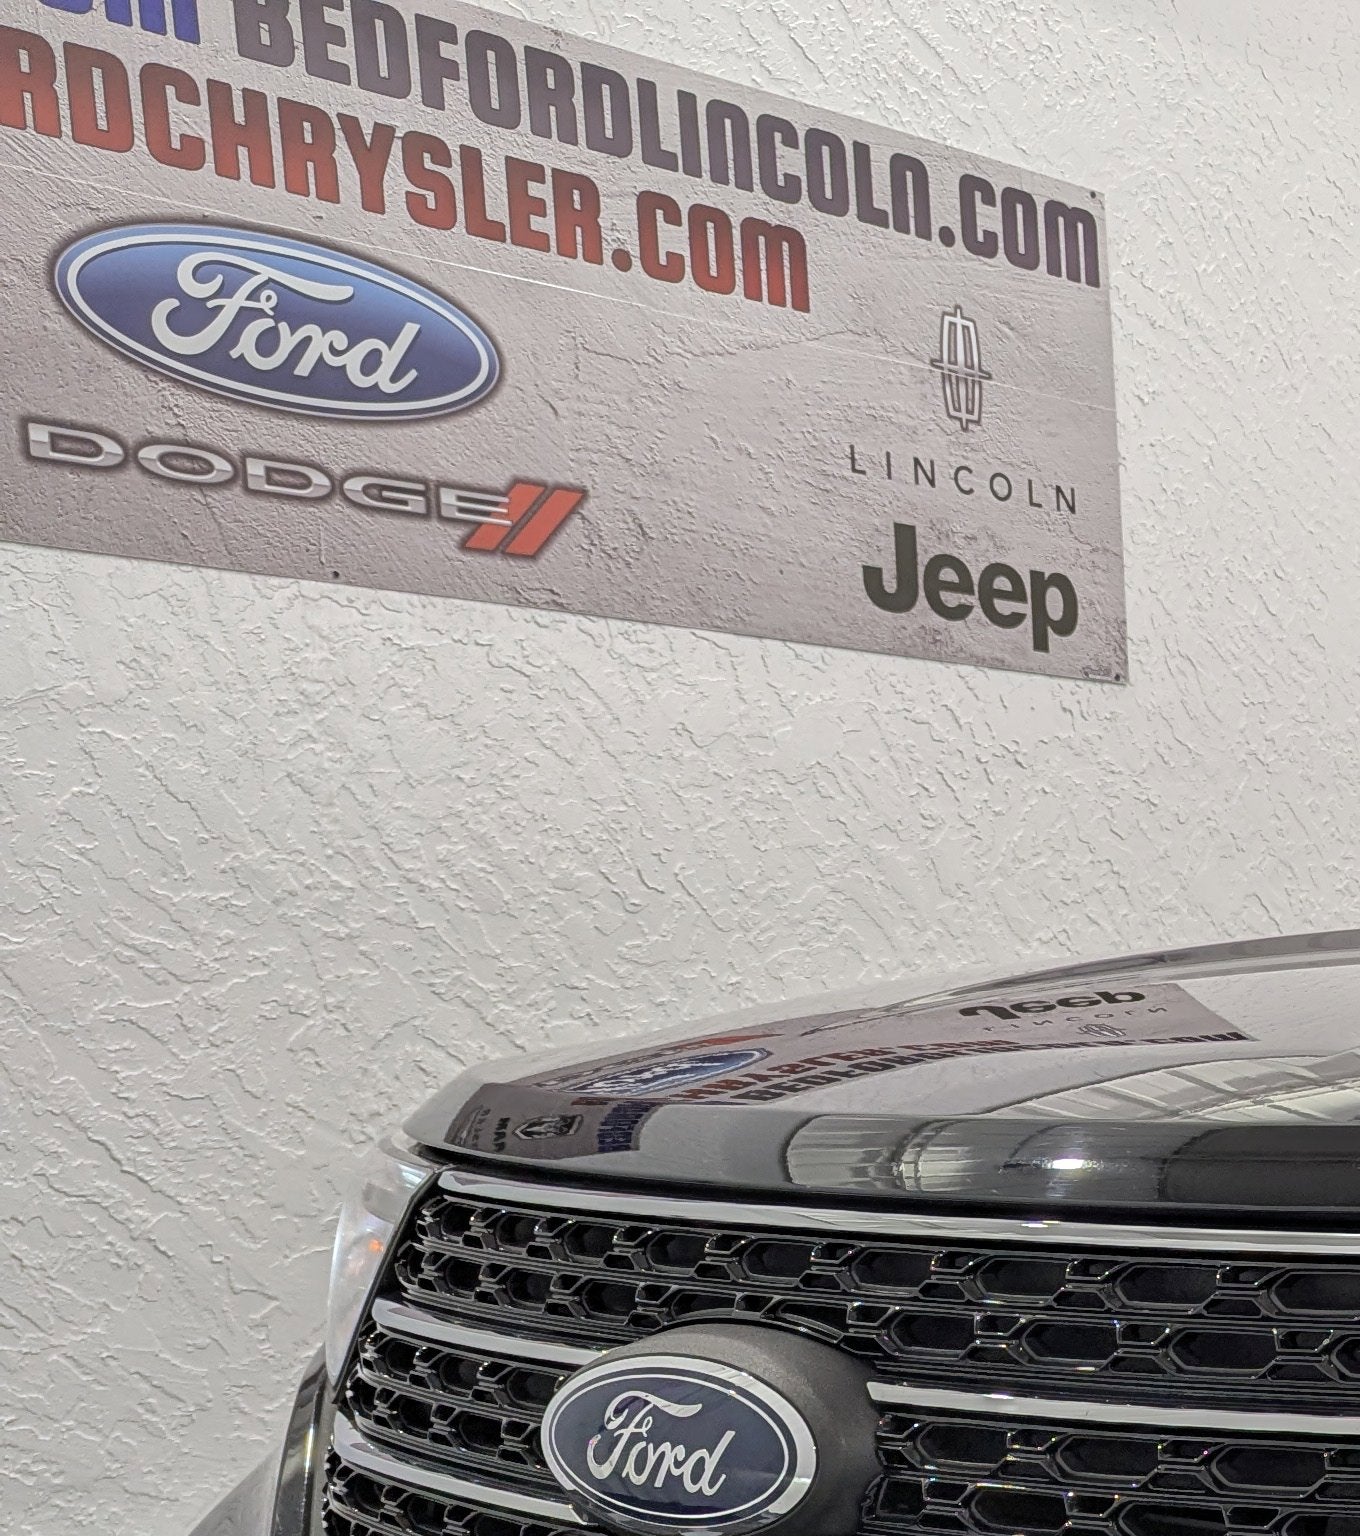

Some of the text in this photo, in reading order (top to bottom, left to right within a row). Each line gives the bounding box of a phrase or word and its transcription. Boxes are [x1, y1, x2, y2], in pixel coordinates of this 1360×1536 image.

[150, 250, 421, 395] Ford
[27, 421, 513, 526] DODGE
[850, 444, 1076, 515] LINCOLN
[862, 521, 1079, 653] Jeep
[586, 1390, 736, 1496] Ford
